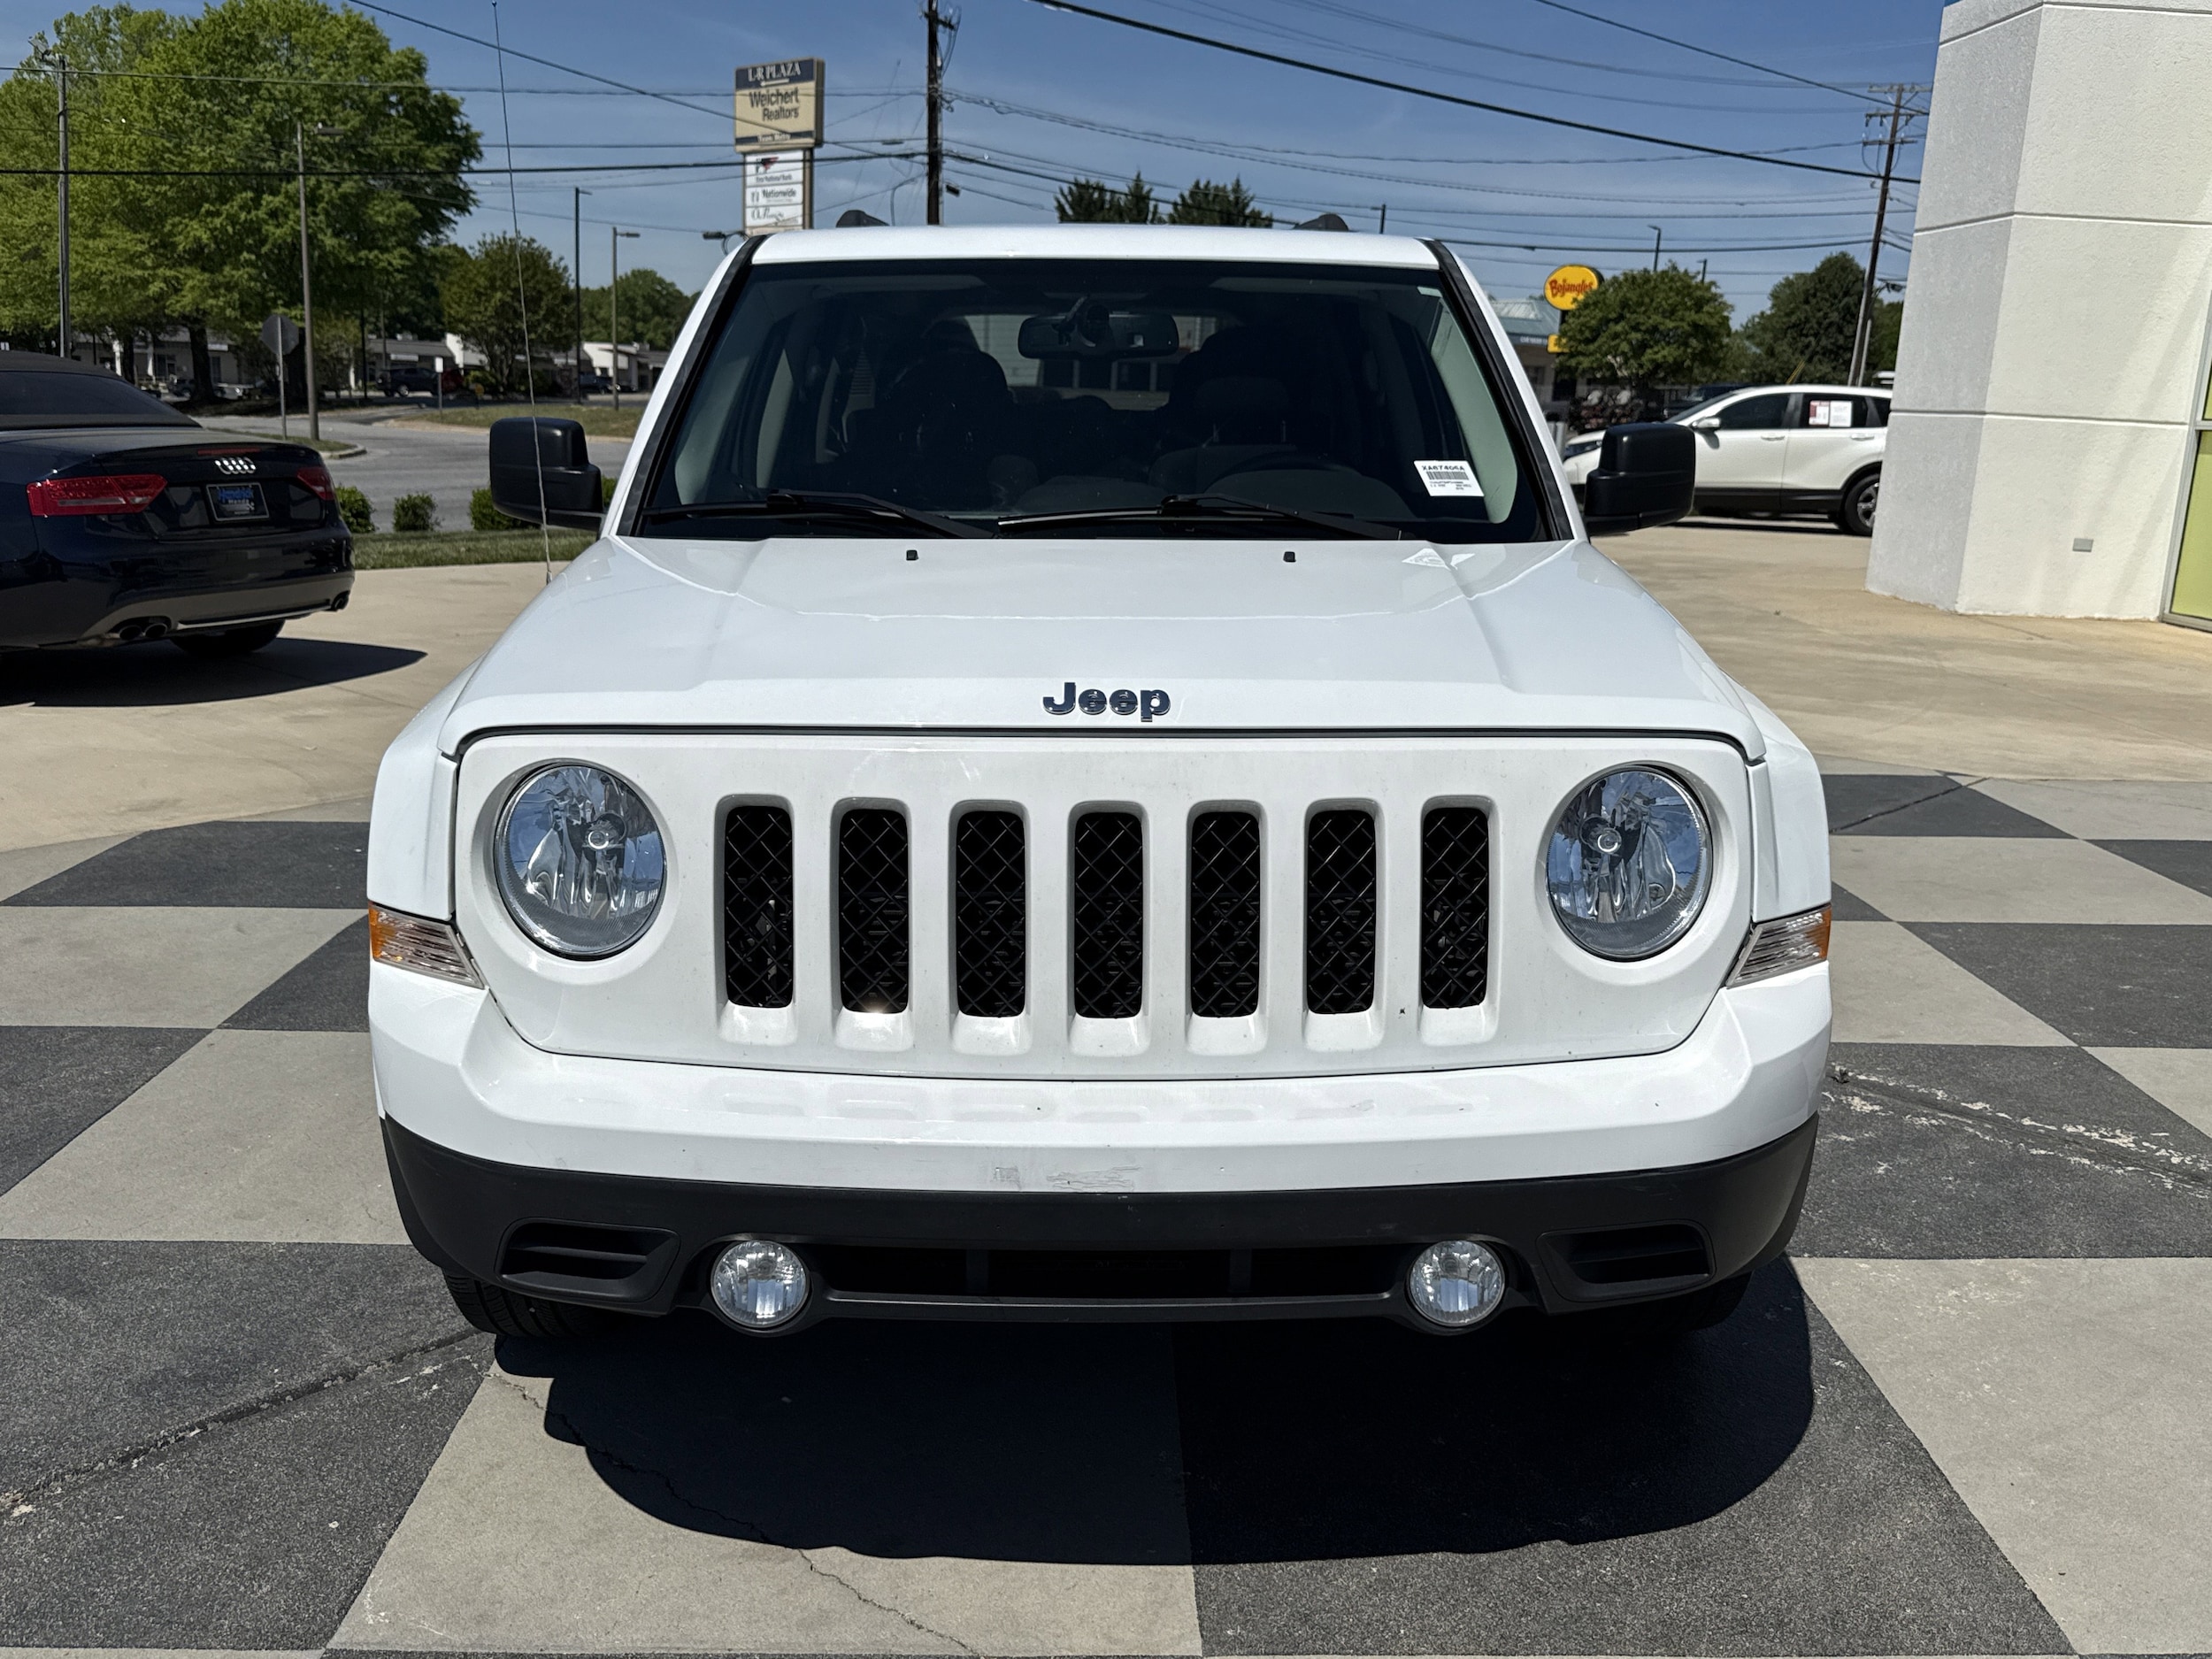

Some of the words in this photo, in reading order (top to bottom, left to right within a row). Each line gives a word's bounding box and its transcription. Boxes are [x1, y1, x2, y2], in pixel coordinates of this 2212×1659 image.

[765, 62, 801, 79] PLAZA
[749, 87, 799, 108] Weichert
[763, 106, 799, 121] Realtors
[762, 188, 796, 199] Nationwide
[1042, 681, 1171, 723] Jeep
